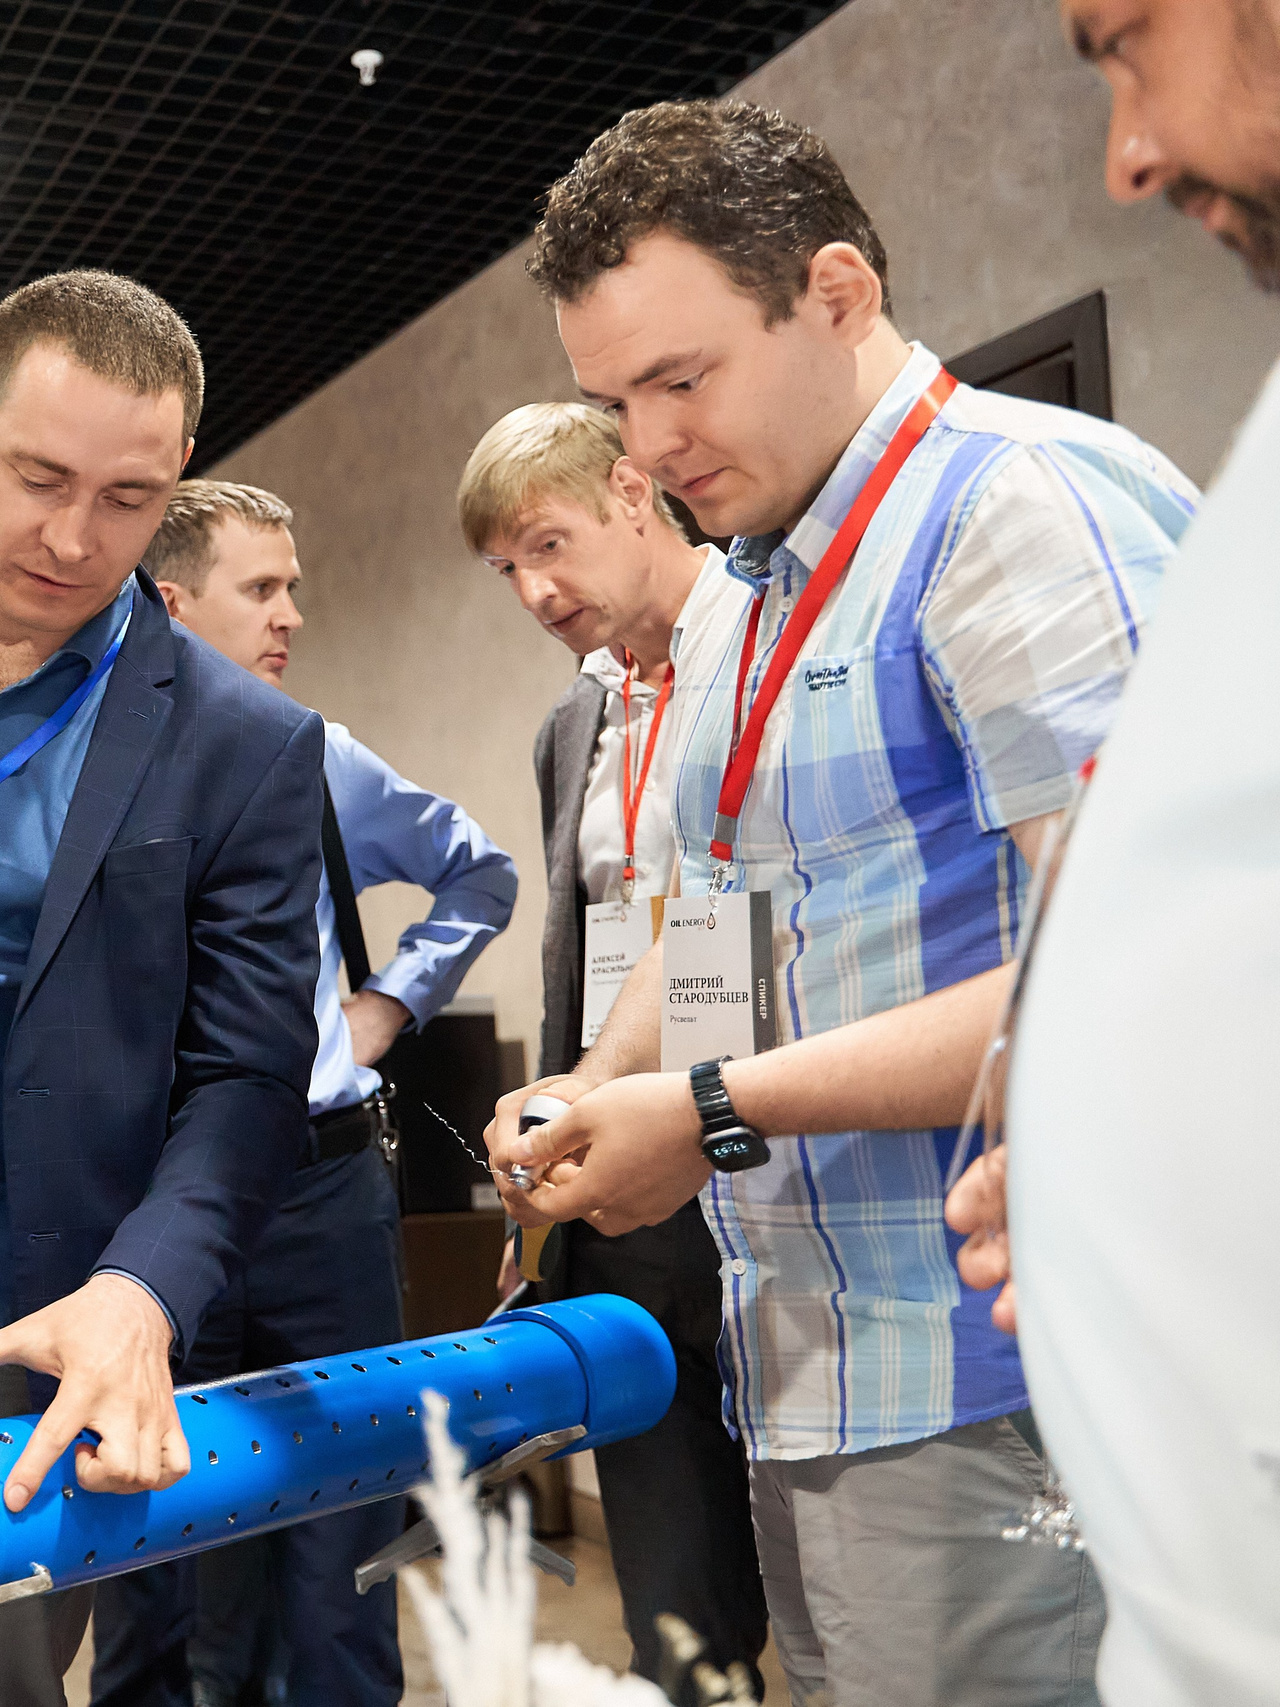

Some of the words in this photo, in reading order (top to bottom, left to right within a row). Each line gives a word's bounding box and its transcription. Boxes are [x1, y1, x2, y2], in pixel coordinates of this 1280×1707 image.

[682, 918, 705, 926] ENERGY
[669, 975, 724, 991] ДМИТРИЙ
[669, 991, 749, 1005] СТАРОДУБЦЕВ
[758, 978, 768, 1020] СПИКЕР
